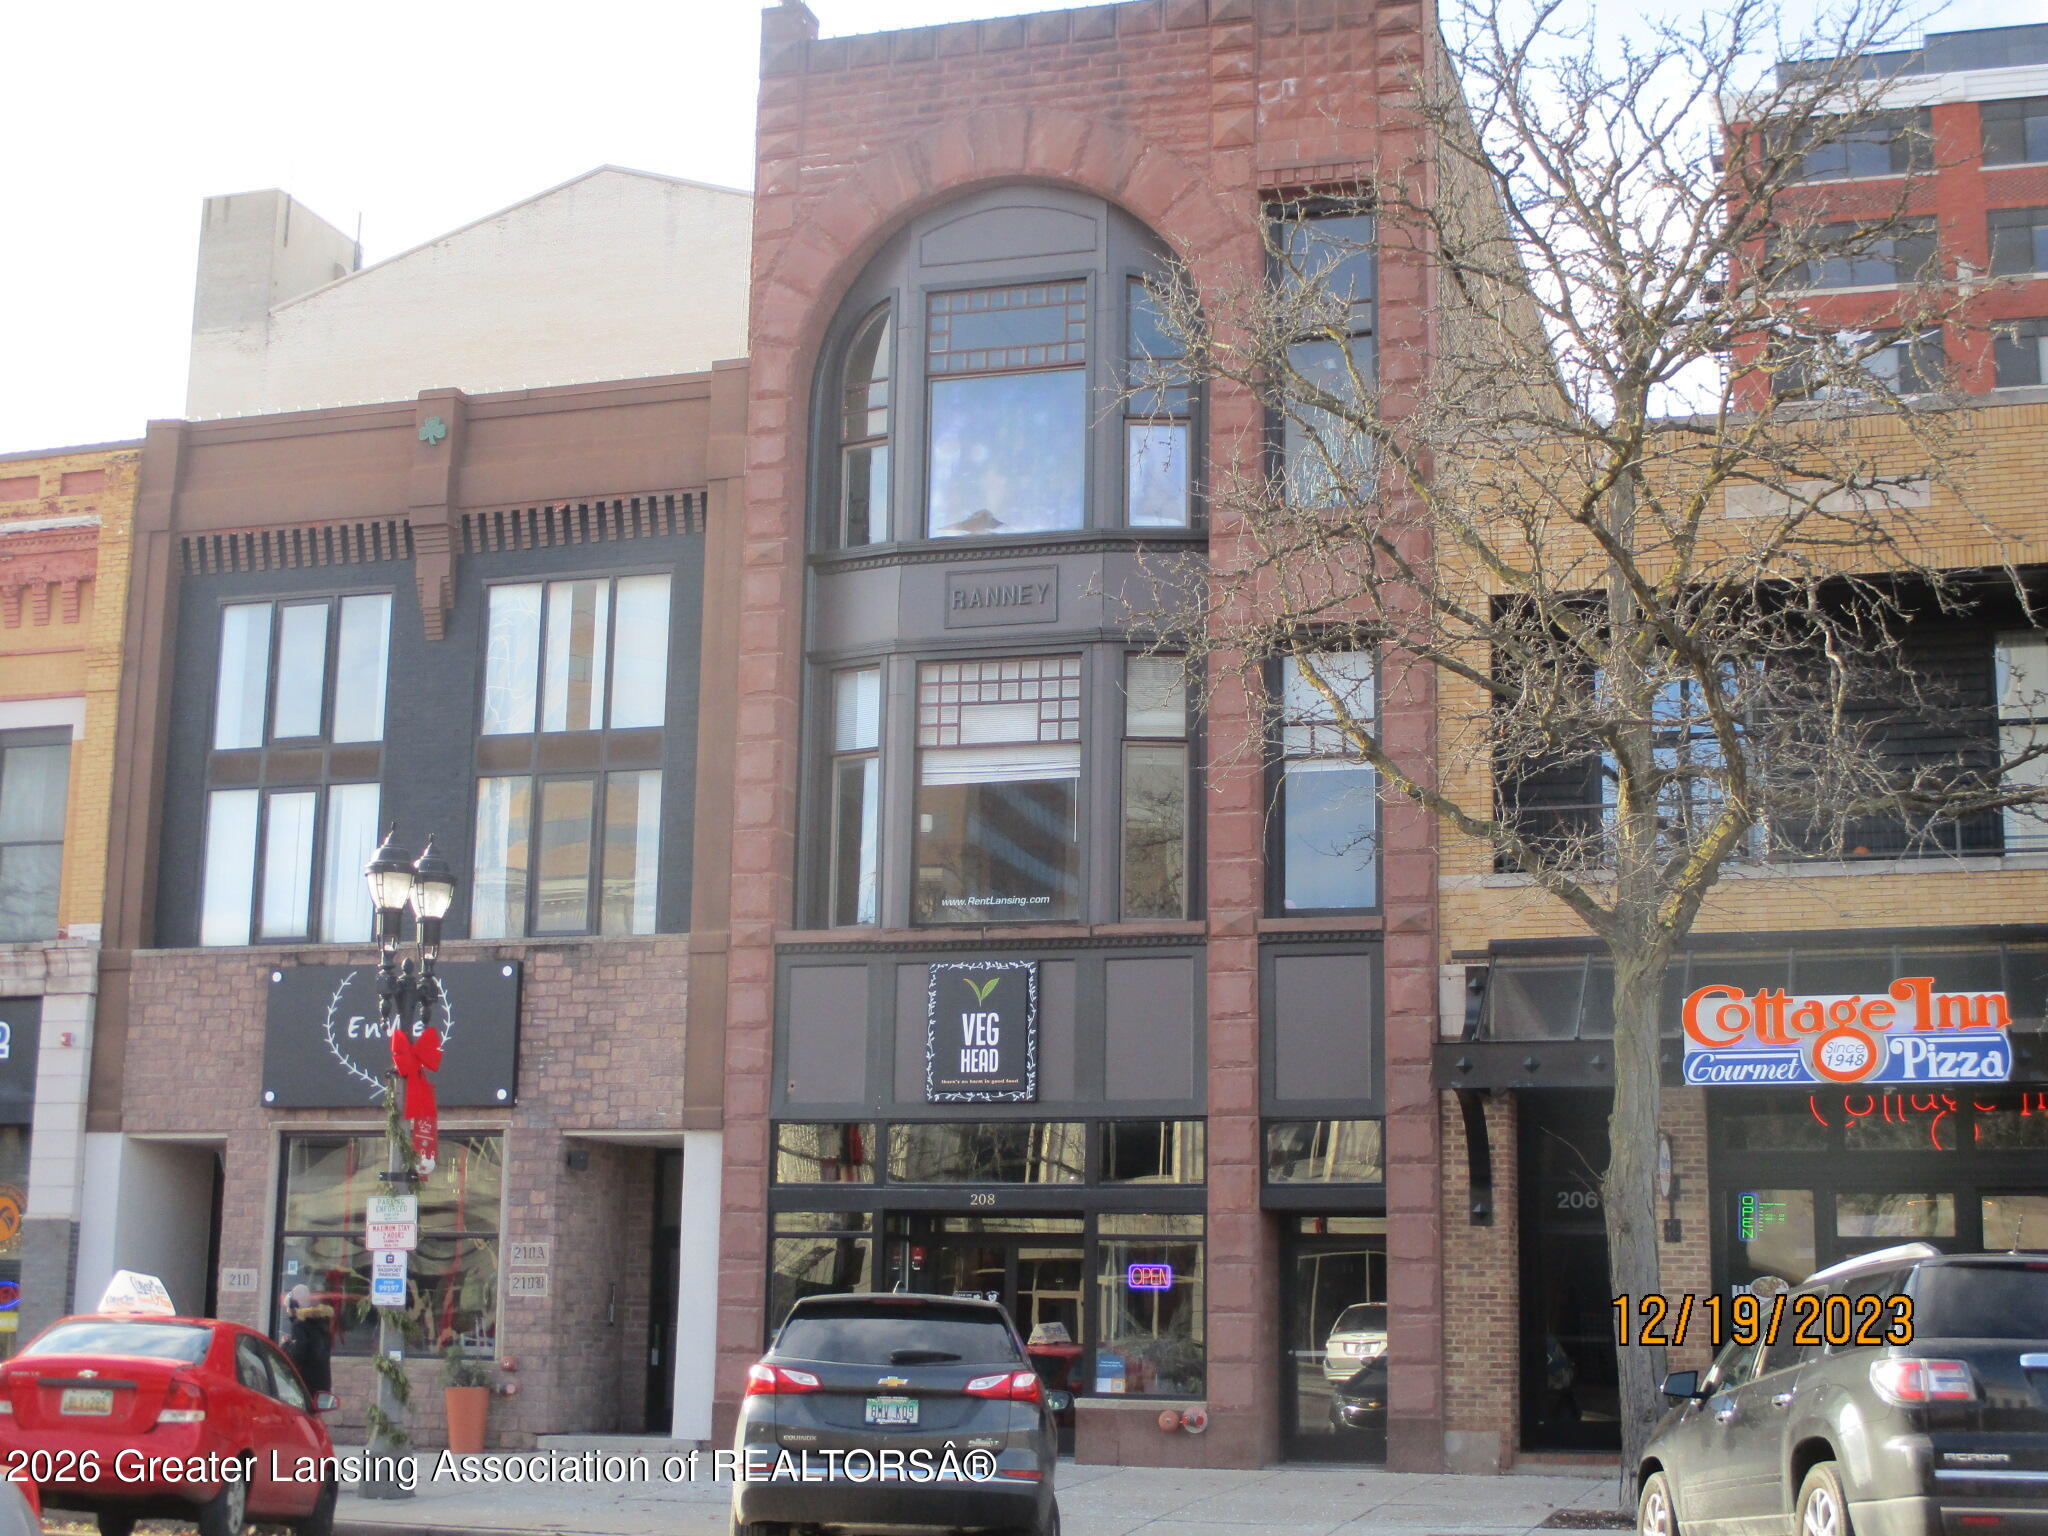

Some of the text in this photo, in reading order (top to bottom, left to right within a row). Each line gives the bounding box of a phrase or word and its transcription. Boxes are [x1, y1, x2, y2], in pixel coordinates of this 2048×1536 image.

[952, 584, 1050, 610] RANNEY
[941, 896, 1050, 907] www.RentLansing.com
[1681, 976, 2013, 1064] Cottage Inn
[962, 1012, 1000, 1047] VEG
[1825, 1041, 1866, 1055] Since
[960, 1048, 999, 1073] HEAD
[1687, 1037, 2006, 1082] Gourmet Pizza
[1825, 1054, 1865, 1067] 1948
[970, 1193, 996, 1206] 208
[1557, 1191, 1599, 1209] 206
[1742, 1195, 1754, 1239] OPEN
[229, 1273, 250, 1286] 210
[1131, 1267, 1169, 1285] OPEN
[1943, 1453, 2010, 1462] ACADIA
